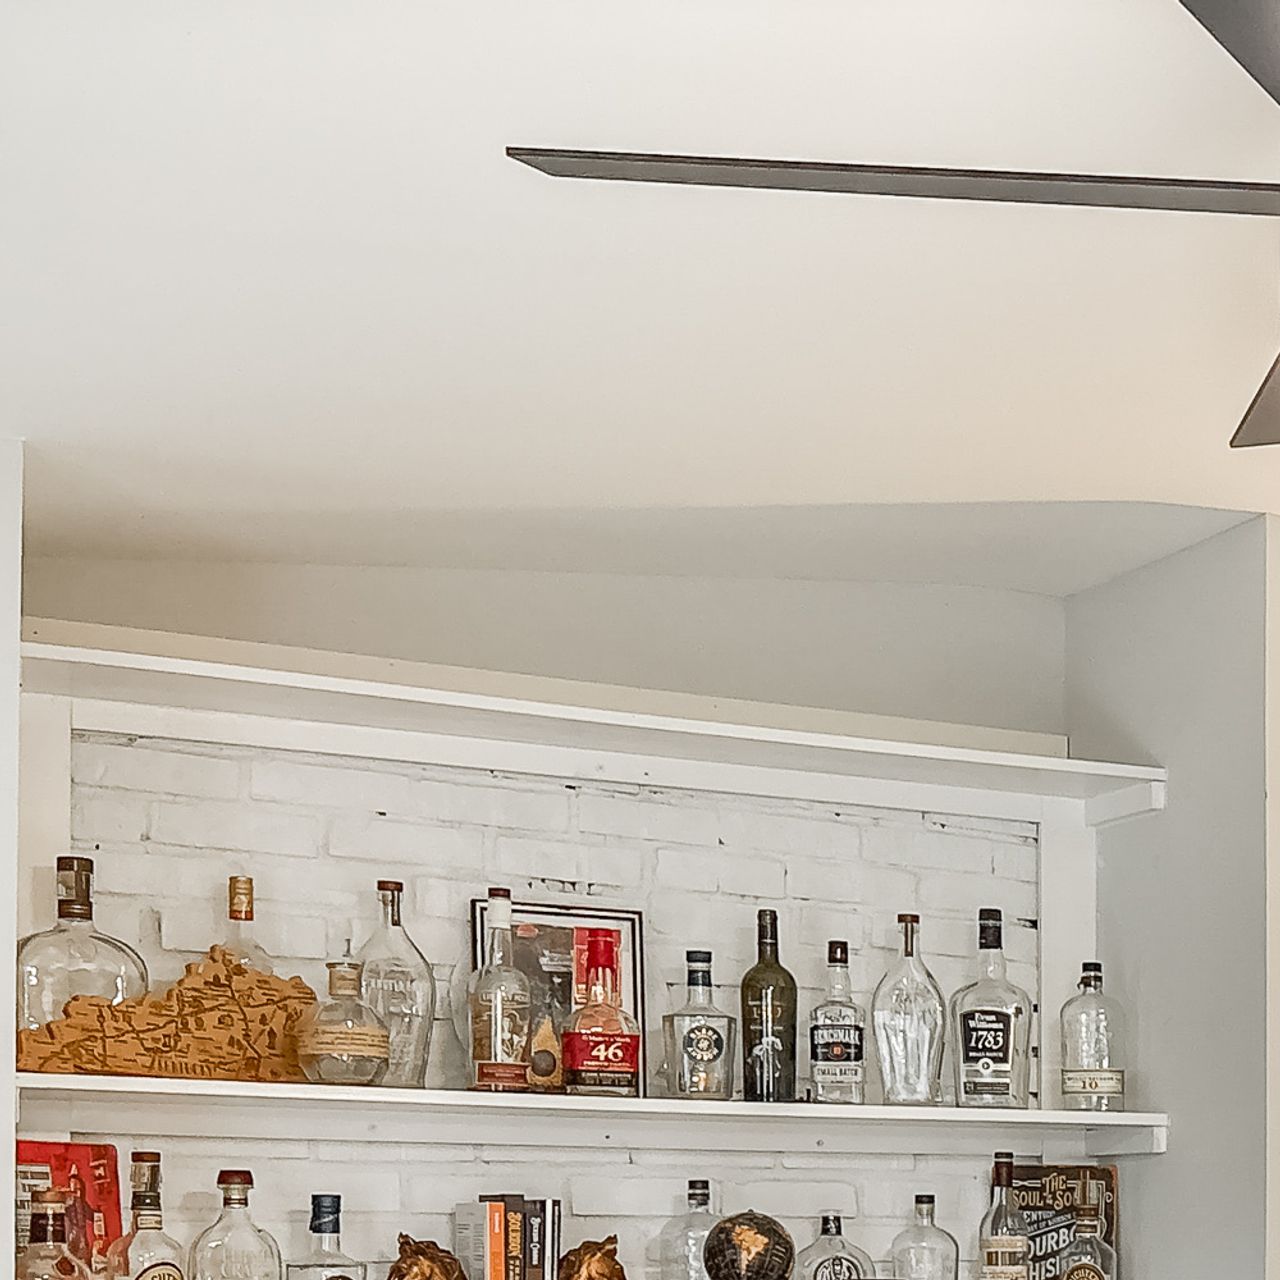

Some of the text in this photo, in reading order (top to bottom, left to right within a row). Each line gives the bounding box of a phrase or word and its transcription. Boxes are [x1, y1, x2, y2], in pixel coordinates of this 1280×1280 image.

[969, 1030, 1004, 1050] 1783
[590, 1042, 624, 1063] 46
[1041, 1171, 1067, 1197] THE
[1012, 1189, 1045, 1209] SOUL
